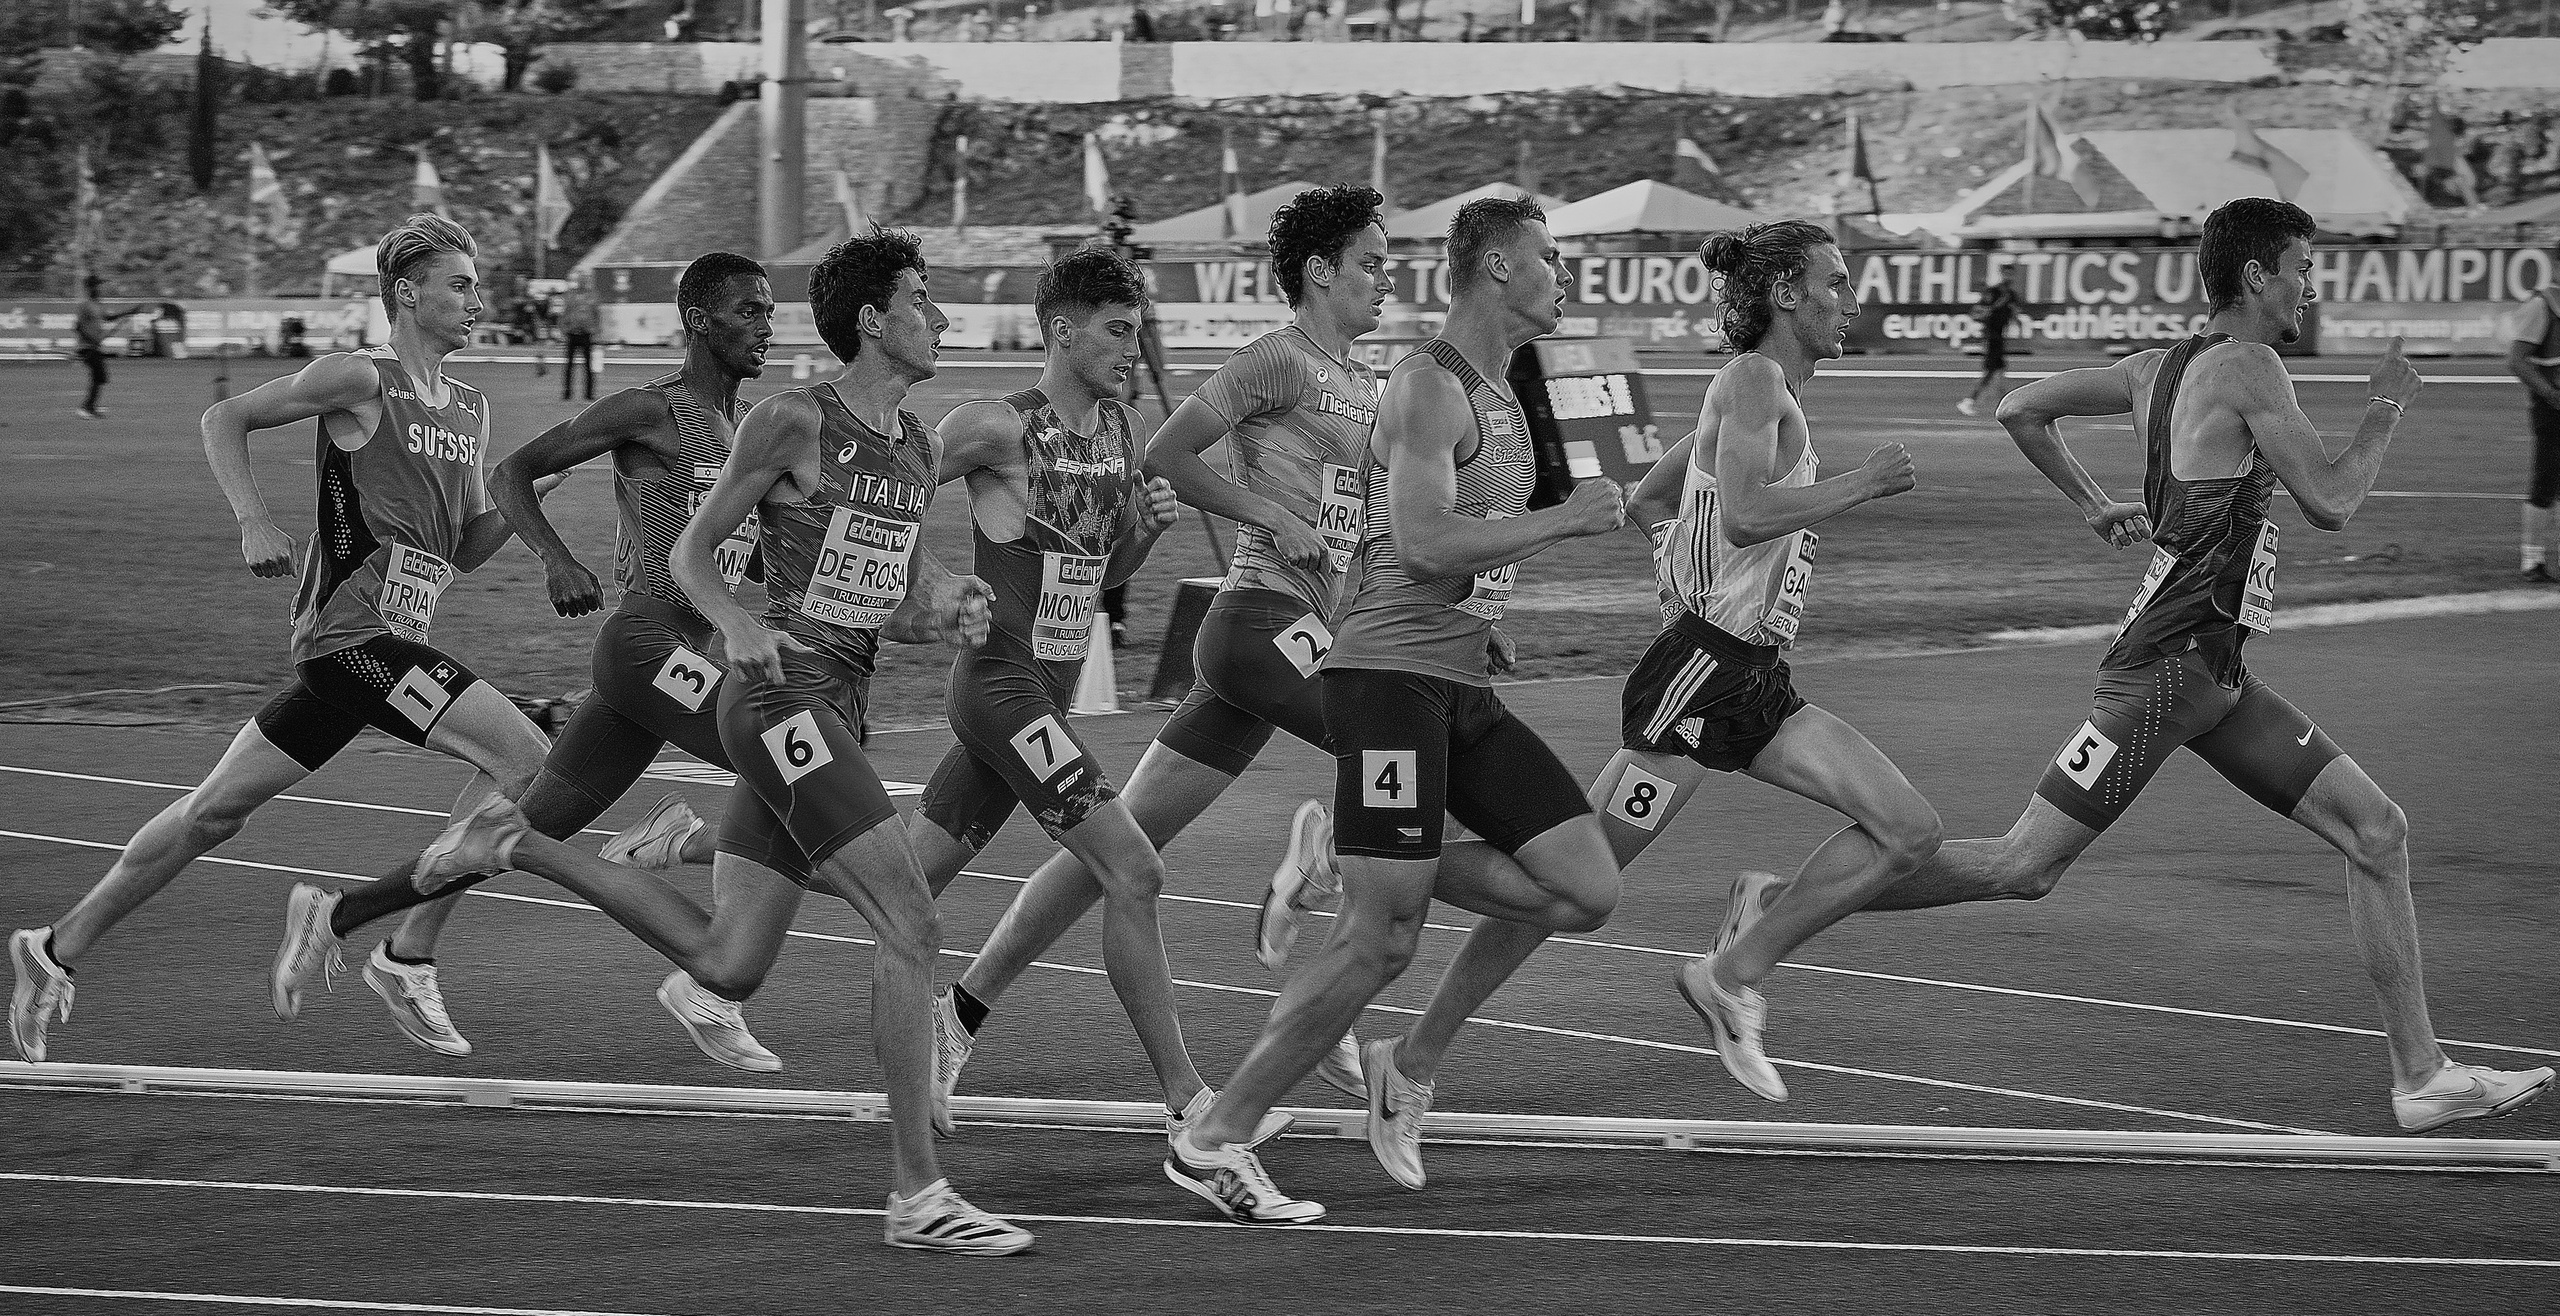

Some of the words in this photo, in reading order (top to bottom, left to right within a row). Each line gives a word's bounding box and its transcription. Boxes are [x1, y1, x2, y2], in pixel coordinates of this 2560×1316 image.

[1580, 257, 1720, 304] EURO
[2155, 253, 2210, 304] U
[2312, 249, 2551, 302] HAMPIO
[398, 389, 416, 400] UBS
[1054, 456, 1125, 477] ESPAÑA
[849, 471, 926, 517] ITALIA
[1319, 502, 1363, 536] KRA
[817, 547, 858, 584] DE
[858, 558, 906, 593] ROSA
[385, 579, 434, 617] TRIA
[839, 591, 861, 605] RUN
[395, 615, 416, 627] RUN
[1290, 629, 1329, 665] 2
[668, 662, 708, 695] 3
[402, 683, 435, 712] 1
[783, 724, 815, 769] 6
[1025, 725, 1055, 769] 7
[1674, 722, 1701, 749] adidas
[2068, 735, 2100, 773] 5
[1055, 767, 1085, 795] ESP
[1374, 760, 1403, 801] 4
[1624, 781, 1659, 820] 8
